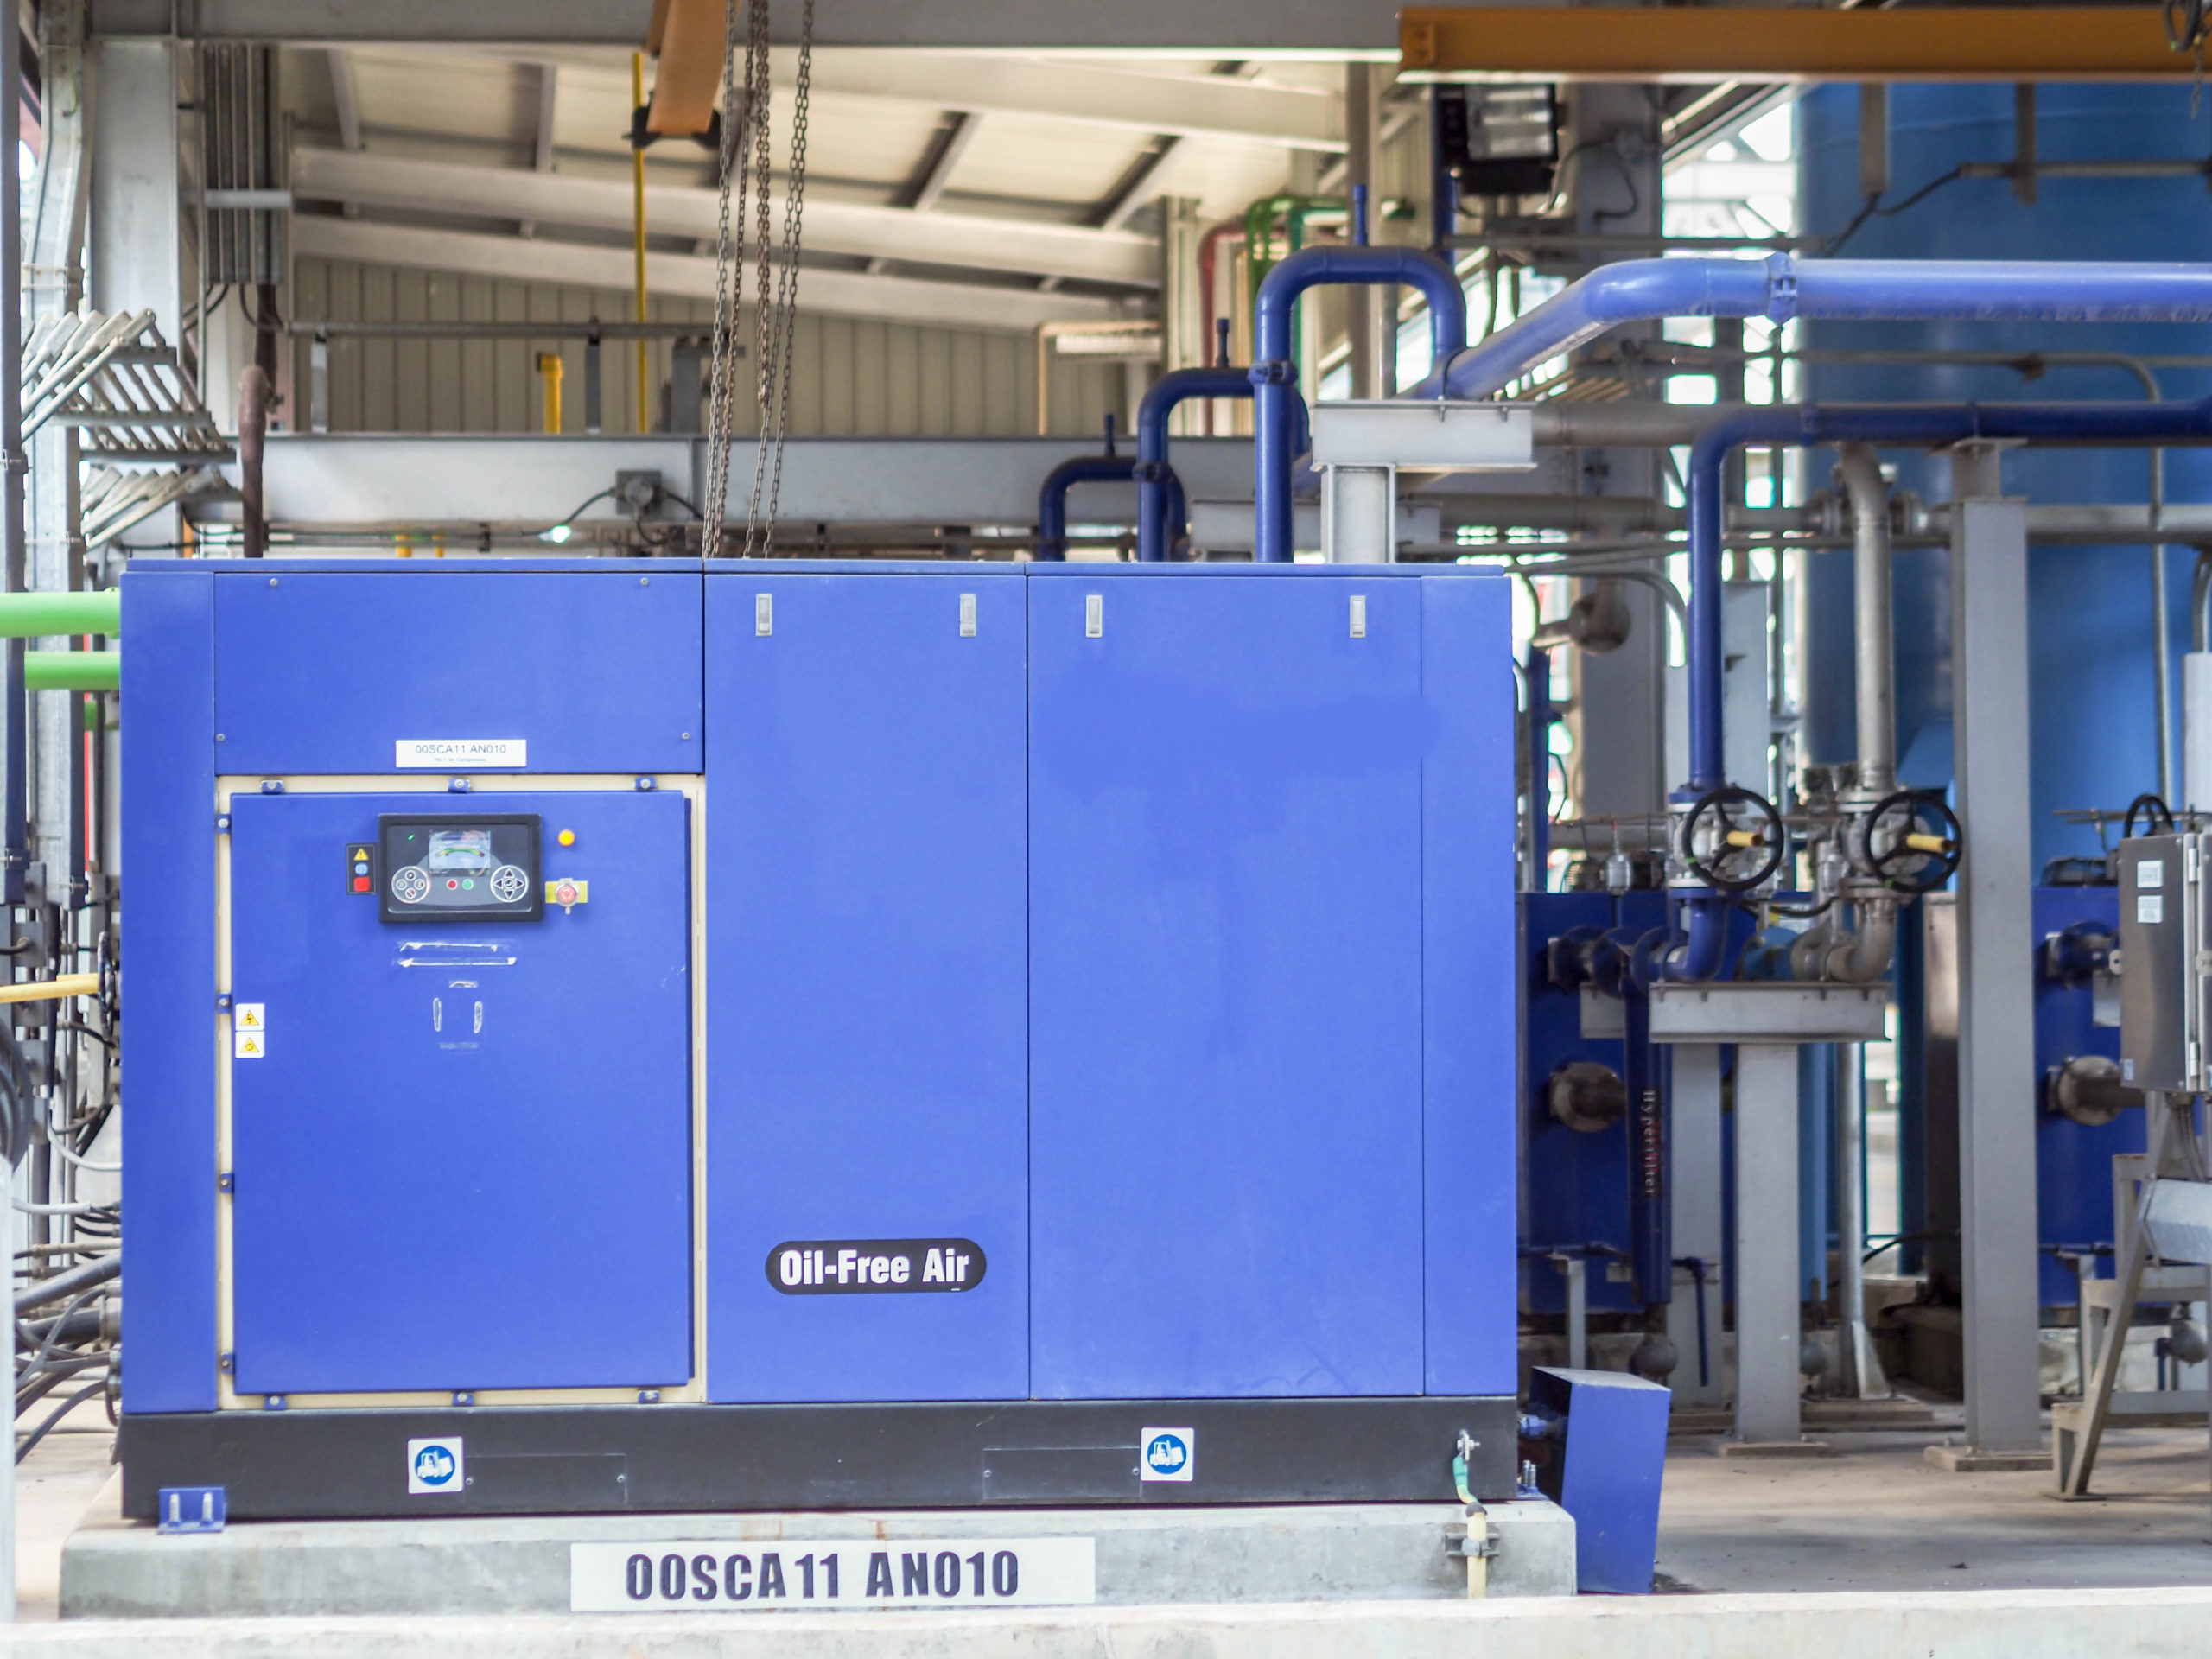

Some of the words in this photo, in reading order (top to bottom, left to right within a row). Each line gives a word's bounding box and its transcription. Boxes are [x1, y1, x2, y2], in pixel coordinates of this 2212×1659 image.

[415, 744, 467, 754] 00SCA11
[470, 744, 507, 754] AN010
[779, 1249, 911, 1286] Oil-Free
[921, 1248, 970, 1282] Air
[626, 1553, 839, 1601] 00SCA11
[865, 1550, 1019, 1598] AN010
